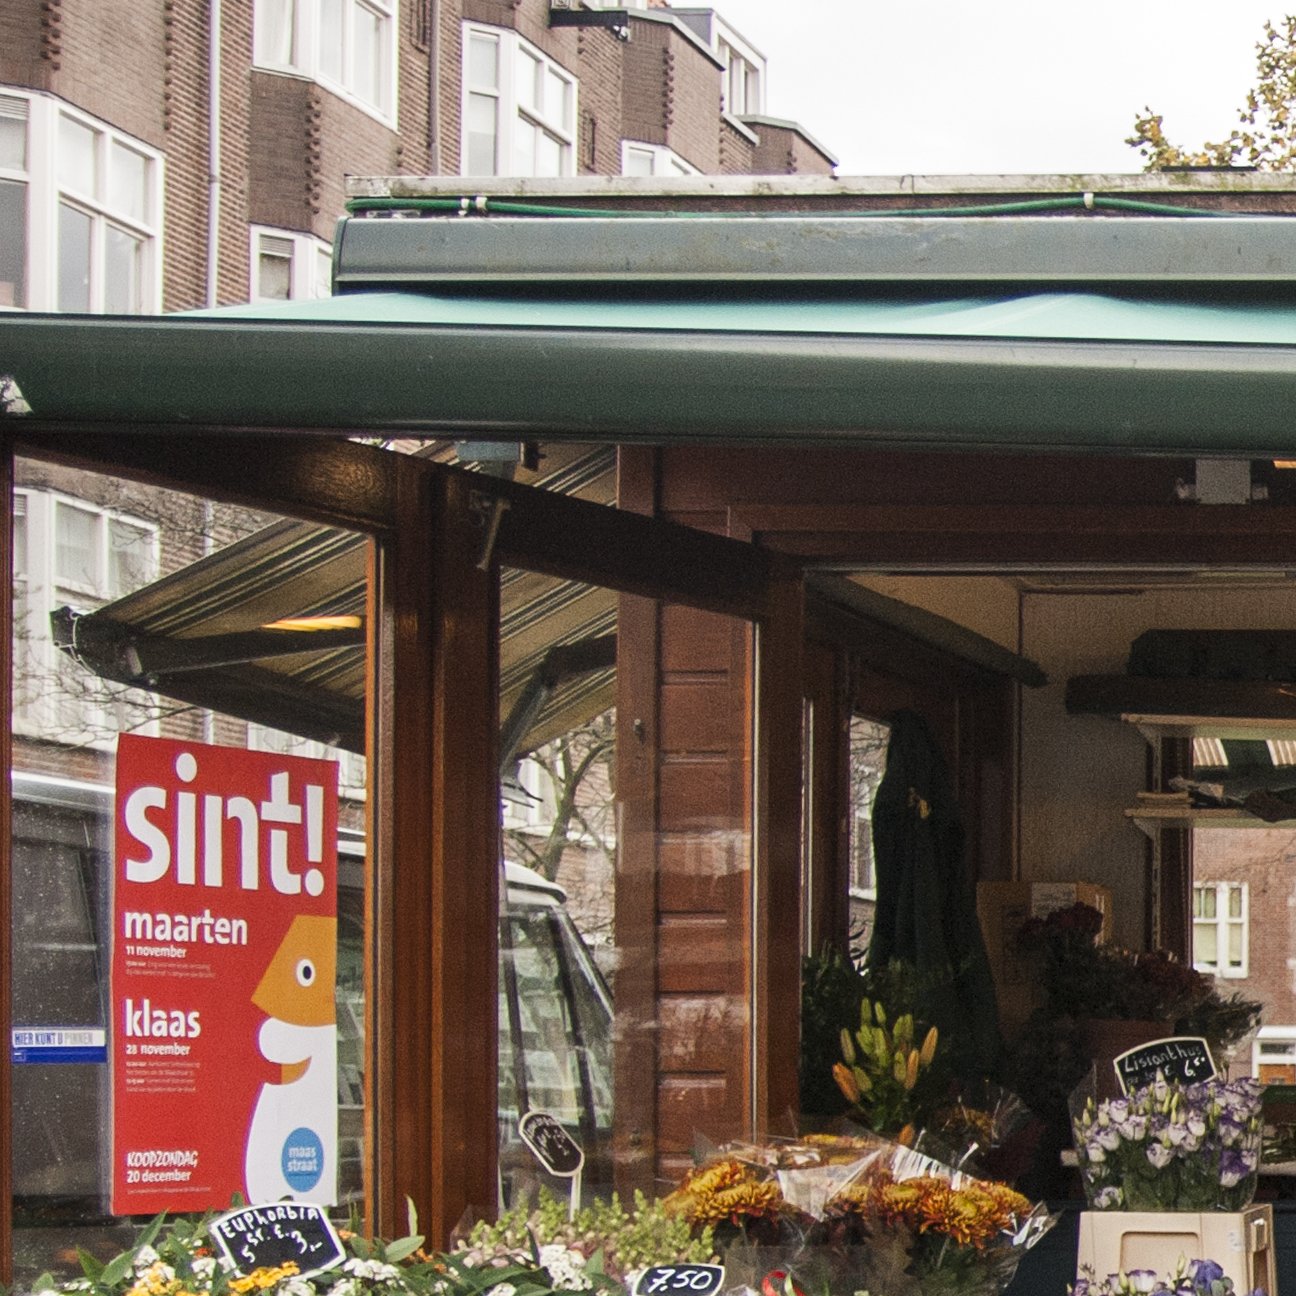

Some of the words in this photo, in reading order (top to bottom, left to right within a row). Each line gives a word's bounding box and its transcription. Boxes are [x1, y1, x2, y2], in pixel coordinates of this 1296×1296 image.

[125, 752, 325, 896] sint!
[124, 909, 247, 945] maarten
[126, 945, 134, 955] 11
[136, 946, 187, 959] november
[124, 998, 202, 1038] klaas
[35, 1032, 55, 1046] KUNT
[58, 1032, 63, 1046] U
[126, 1044, 137, 1054] 28
[140, 1044, 191, 1056] november
[1124, 1043, 1202, 1073] Lisianthus
[127, 1151, 198, 1167] KOOPZONDAG
[288, 1147, 316, 1158] maas
[287, 1158, 318, 1171] straat
[127, 1171, 139, 1183] 20
[142, 1169, 191, 1182] december
